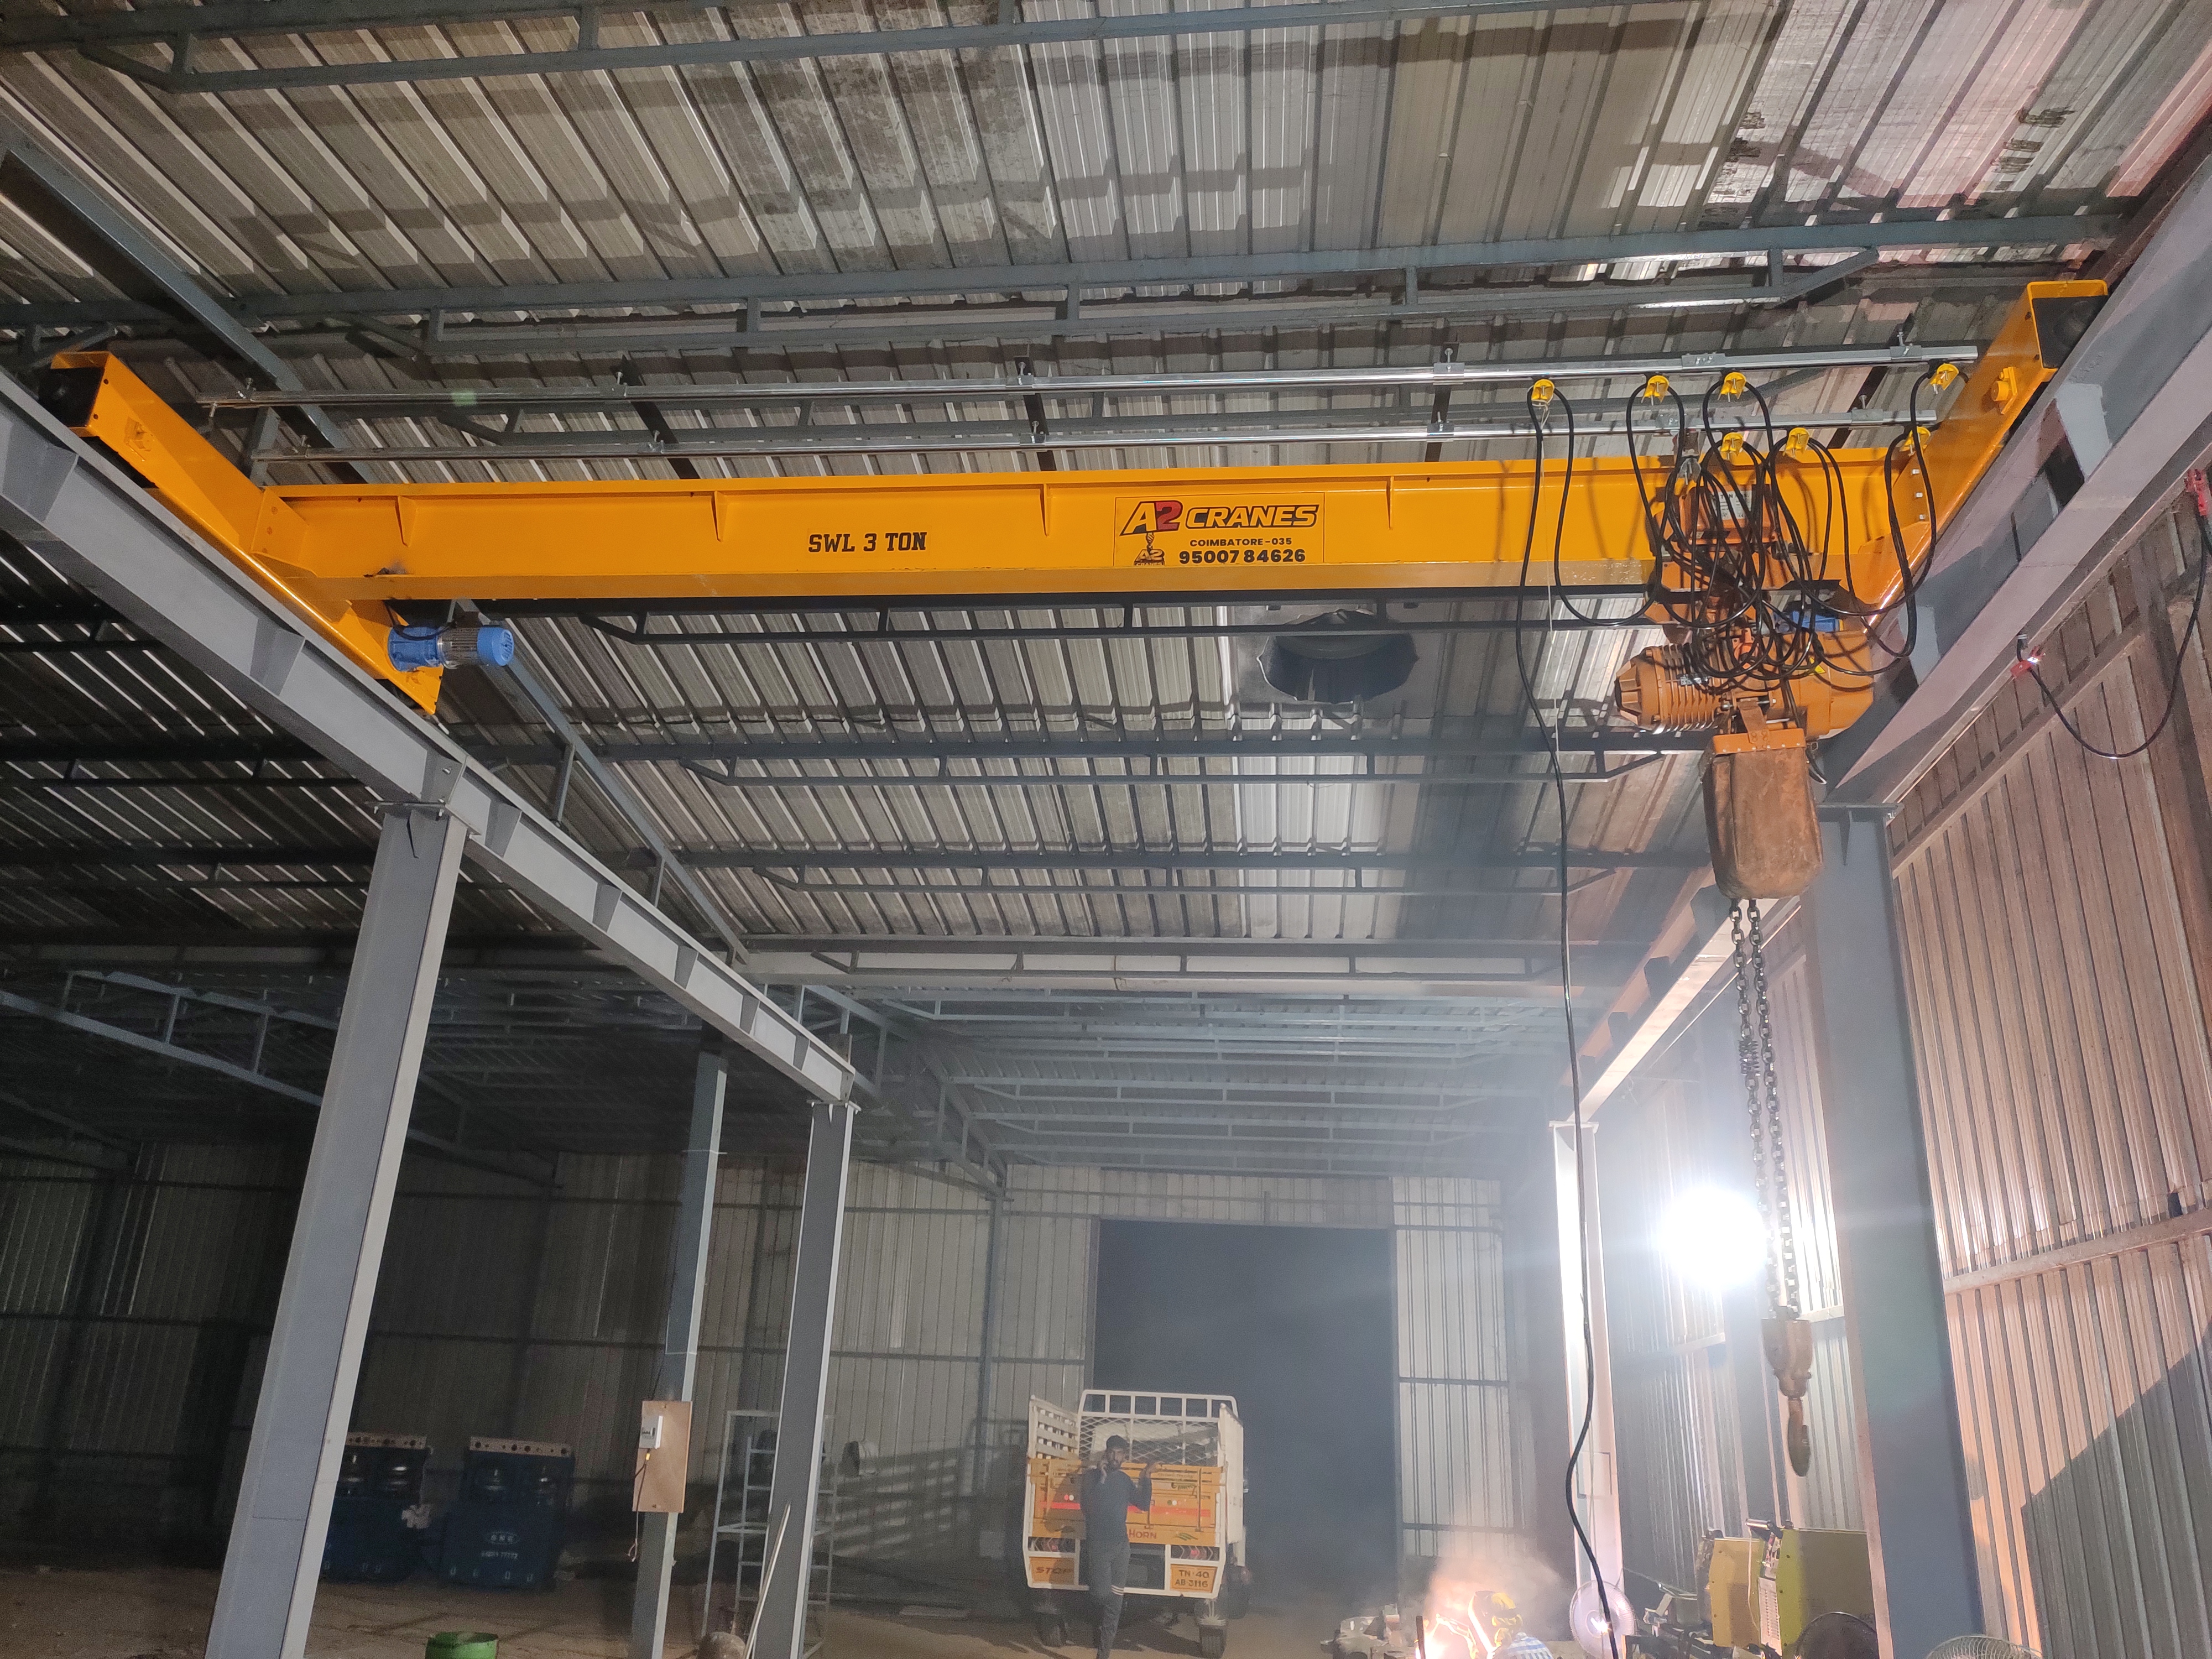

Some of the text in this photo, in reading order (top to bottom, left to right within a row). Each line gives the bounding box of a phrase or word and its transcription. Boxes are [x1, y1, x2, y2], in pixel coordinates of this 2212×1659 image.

[1119, 500, 1319, 536] A2 CRANES
[808, 532, 927, 552] SWL 3 TON
[1134, 549, 1165, 561] A2
[1129, 1528, 1157, 1539] HORN
